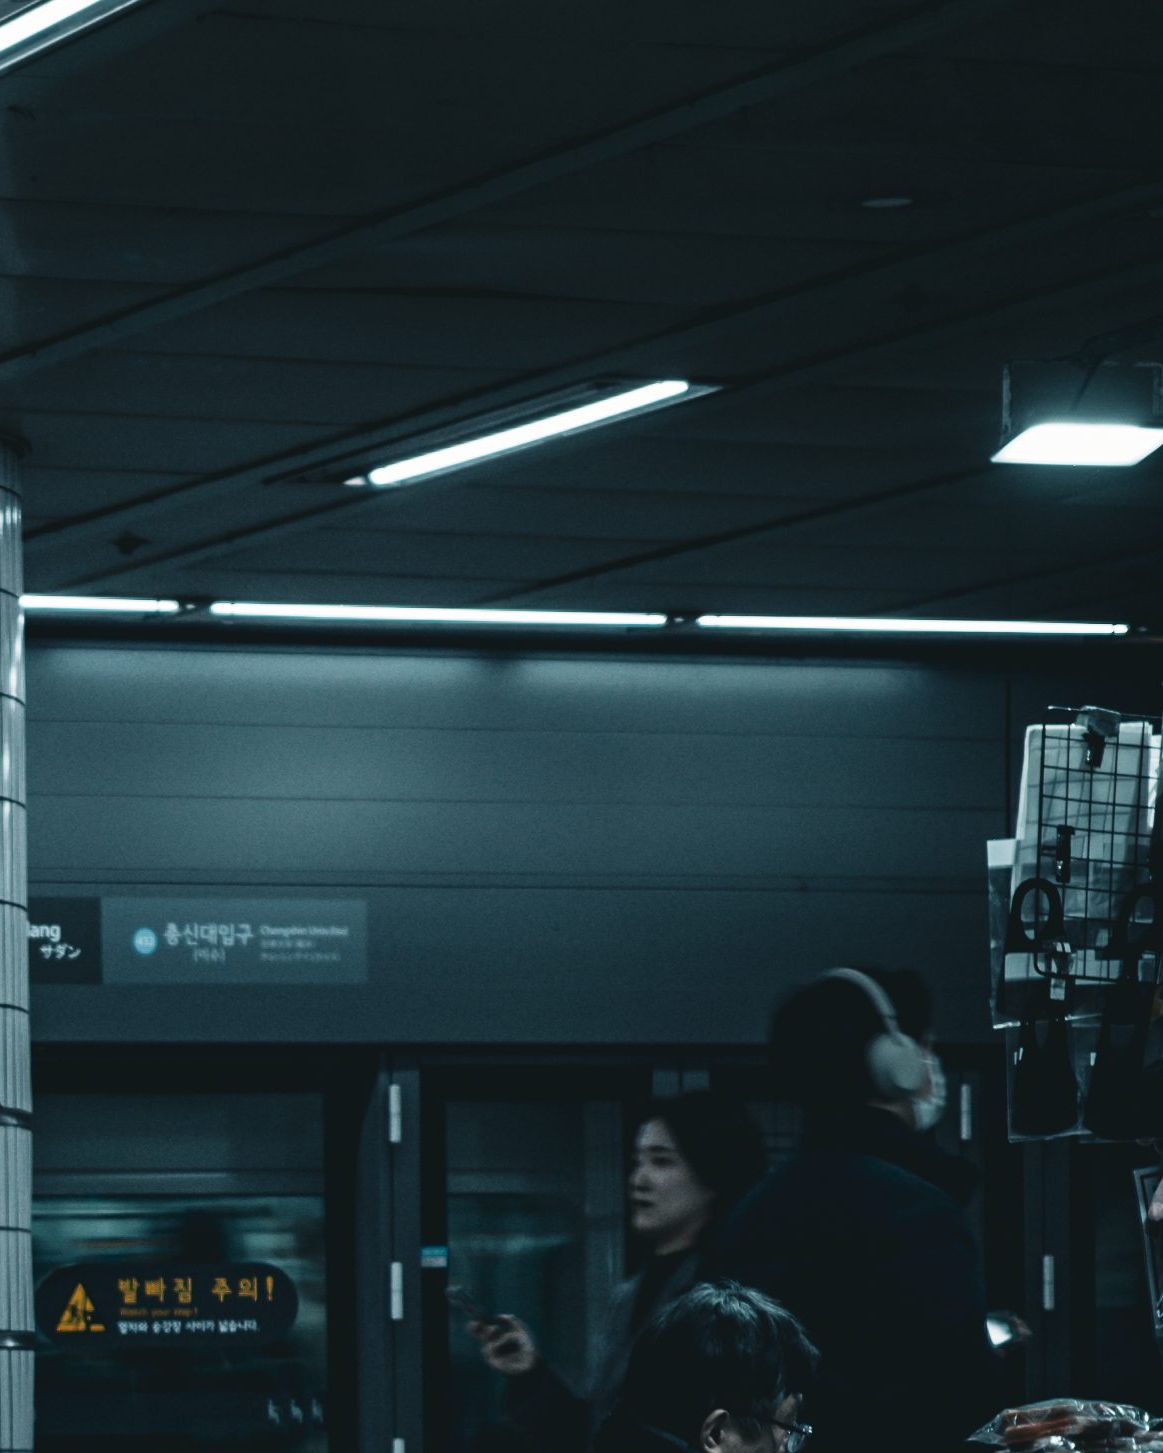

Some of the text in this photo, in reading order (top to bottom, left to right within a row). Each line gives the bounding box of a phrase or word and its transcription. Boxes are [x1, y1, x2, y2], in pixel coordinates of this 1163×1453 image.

[28, 924, 61, 942] ang
[163, 922, 253, 947] 총신대입구
[118, 1275, 274, 1303] 발빠짐 주의!
